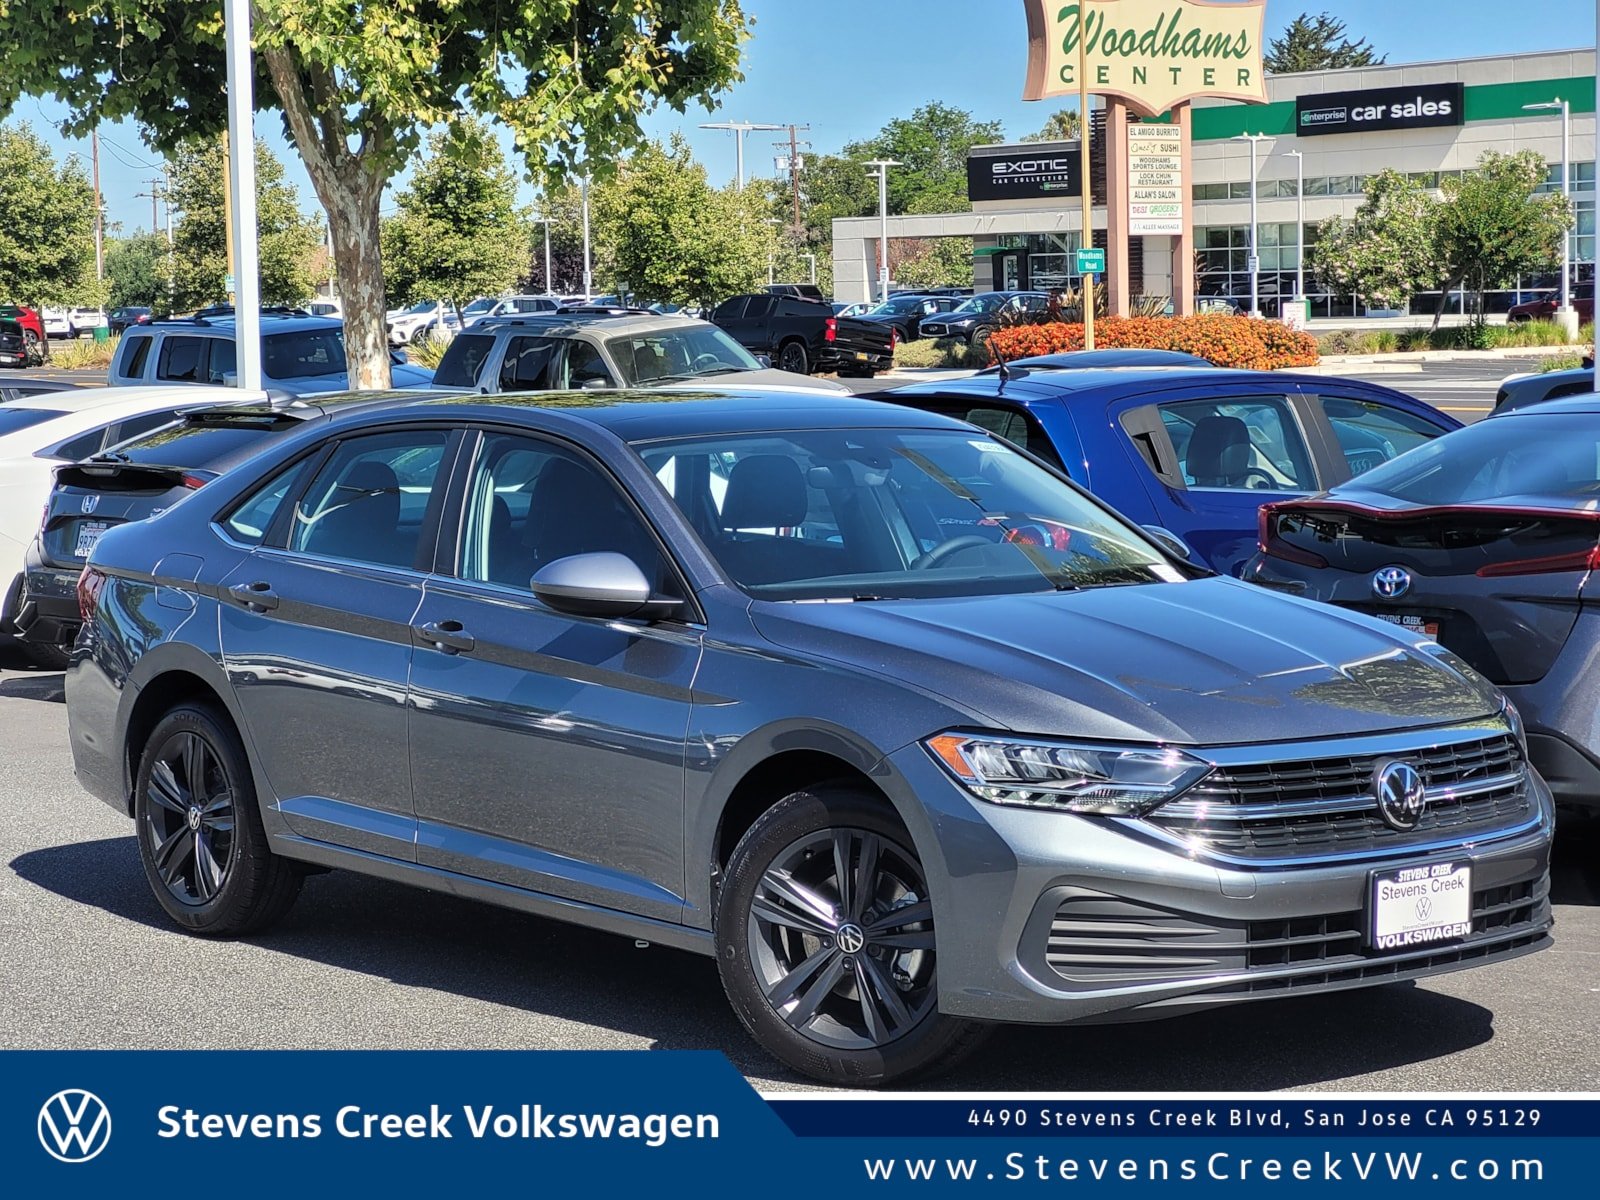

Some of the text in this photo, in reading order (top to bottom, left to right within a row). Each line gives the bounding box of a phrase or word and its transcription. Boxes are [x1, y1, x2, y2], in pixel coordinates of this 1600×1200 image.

[1057, 5, 1252, 59] Woodhams
[1059, 64, 1250, 87] CENTER
[1301, 96, 1452, 122] enterprise car sales
[1130, 128, 1179, 136] EL AMIGO BURRITO
[1160, 143, 1179, 153] SUSHI
[992, 159, 1068, 173] EXOTIC
[1014, 175, 1069, 183] COLLECTION
[1134, 191, 1176, 199] ALLAN'S SALON
[1402, 615, 1422, 625] CREEK
[1398, 862, 1453, 883] STEVENS CREEK
[1381, 875, 1465, 901] Stevens Creek
[1376, 922, 1472, 949] VOLKSWAGEN
